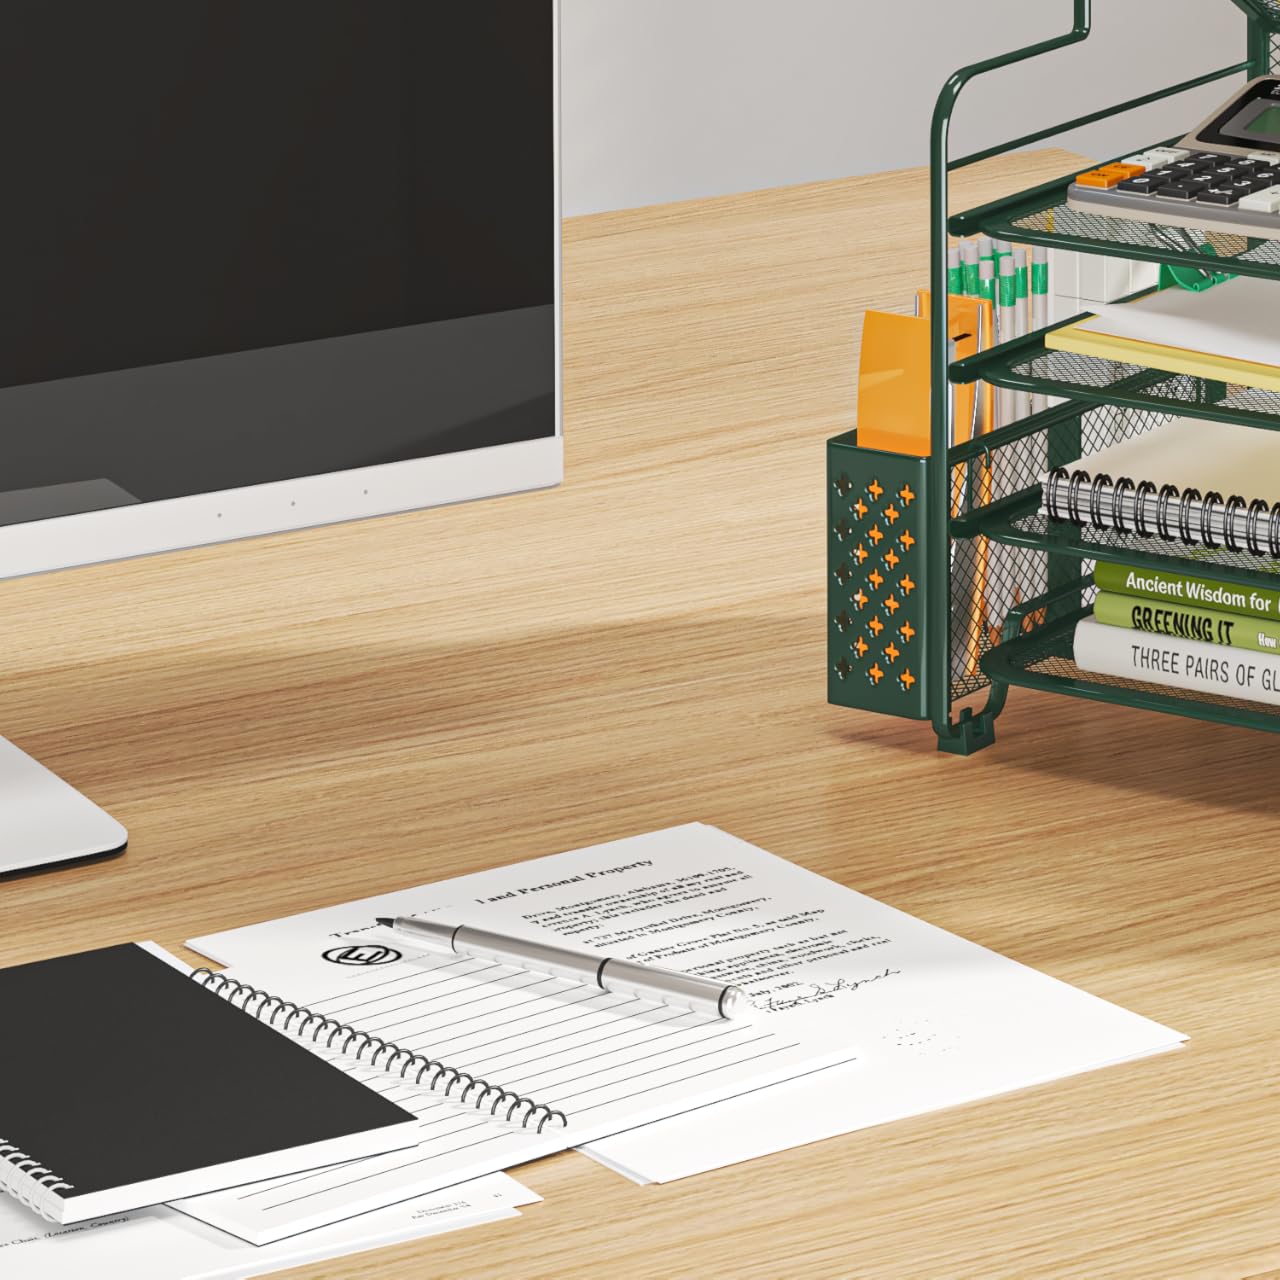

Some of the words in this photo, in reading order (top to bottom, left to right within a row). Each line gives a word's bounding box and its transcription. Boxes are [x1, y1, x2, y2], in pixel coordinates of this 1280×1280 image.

[1126, 571, 1182, 597] Ancient
[1186, 581, 1246, 609] Wisdom
[1249, 592, 1271, 612] for
[1131, 605, 1214, 642] GREENING
[1217, 620, 1235, 645] IT
[1257, 632, 1277, 648] How
[1131, 644, 1180, 674] THREE
[1185, 654, 1230, 683] PAIRS
[1235, 663, 1256, 687] OF
[487, 891, 518, 903] and
[517, 875, 585, 895] Personal
[585, 859, 653, 879] Property
[542, 917, 579, 928] errence
[554, 919, 599, 932] roperty;
[680, 960, 725, 973] ersonal
